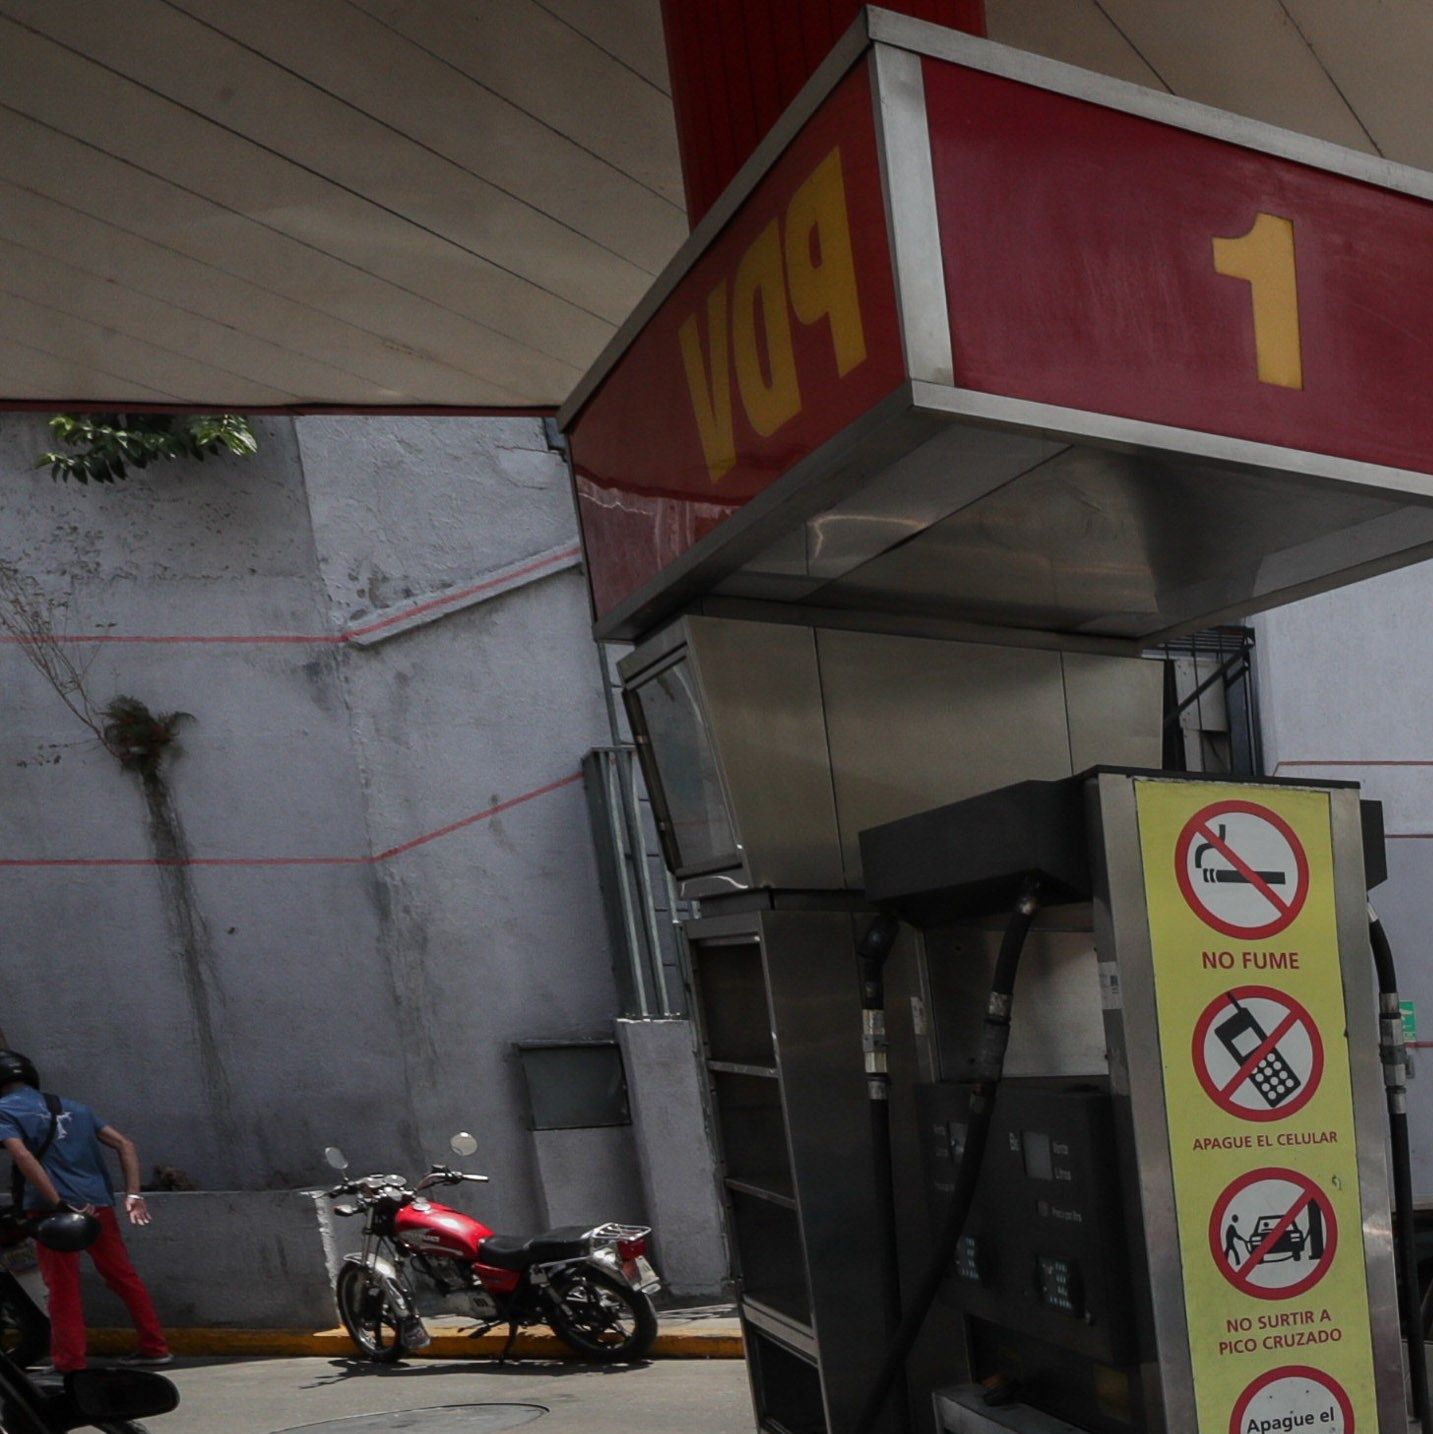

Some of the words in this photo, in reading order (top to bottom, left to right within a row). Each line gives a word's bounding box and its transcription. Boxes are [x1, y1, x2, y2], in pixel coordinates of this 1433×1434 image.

[1212, 212, 1304, 391] 1
[1201, 951, 1235, 970] NO
[1242, 952, 1300, 970] FUME
[1192, 1135, 1252, 1151] APAGUE
[1257, 1134, 1272, 1148] EL
[1277, 1131, 1338, 1147] CELULAR
[1226, 1316, 1252, 1333] NO
[1258, 1311, 1314, 1331] SURTIR
[1319, 1309, 1332, 1323] A
[1219, 1337, 1257, 1355] PICO
[1262, 1328, 1343, 1350] CRUZADO
[1320, 1407, 1335, 1423] el
